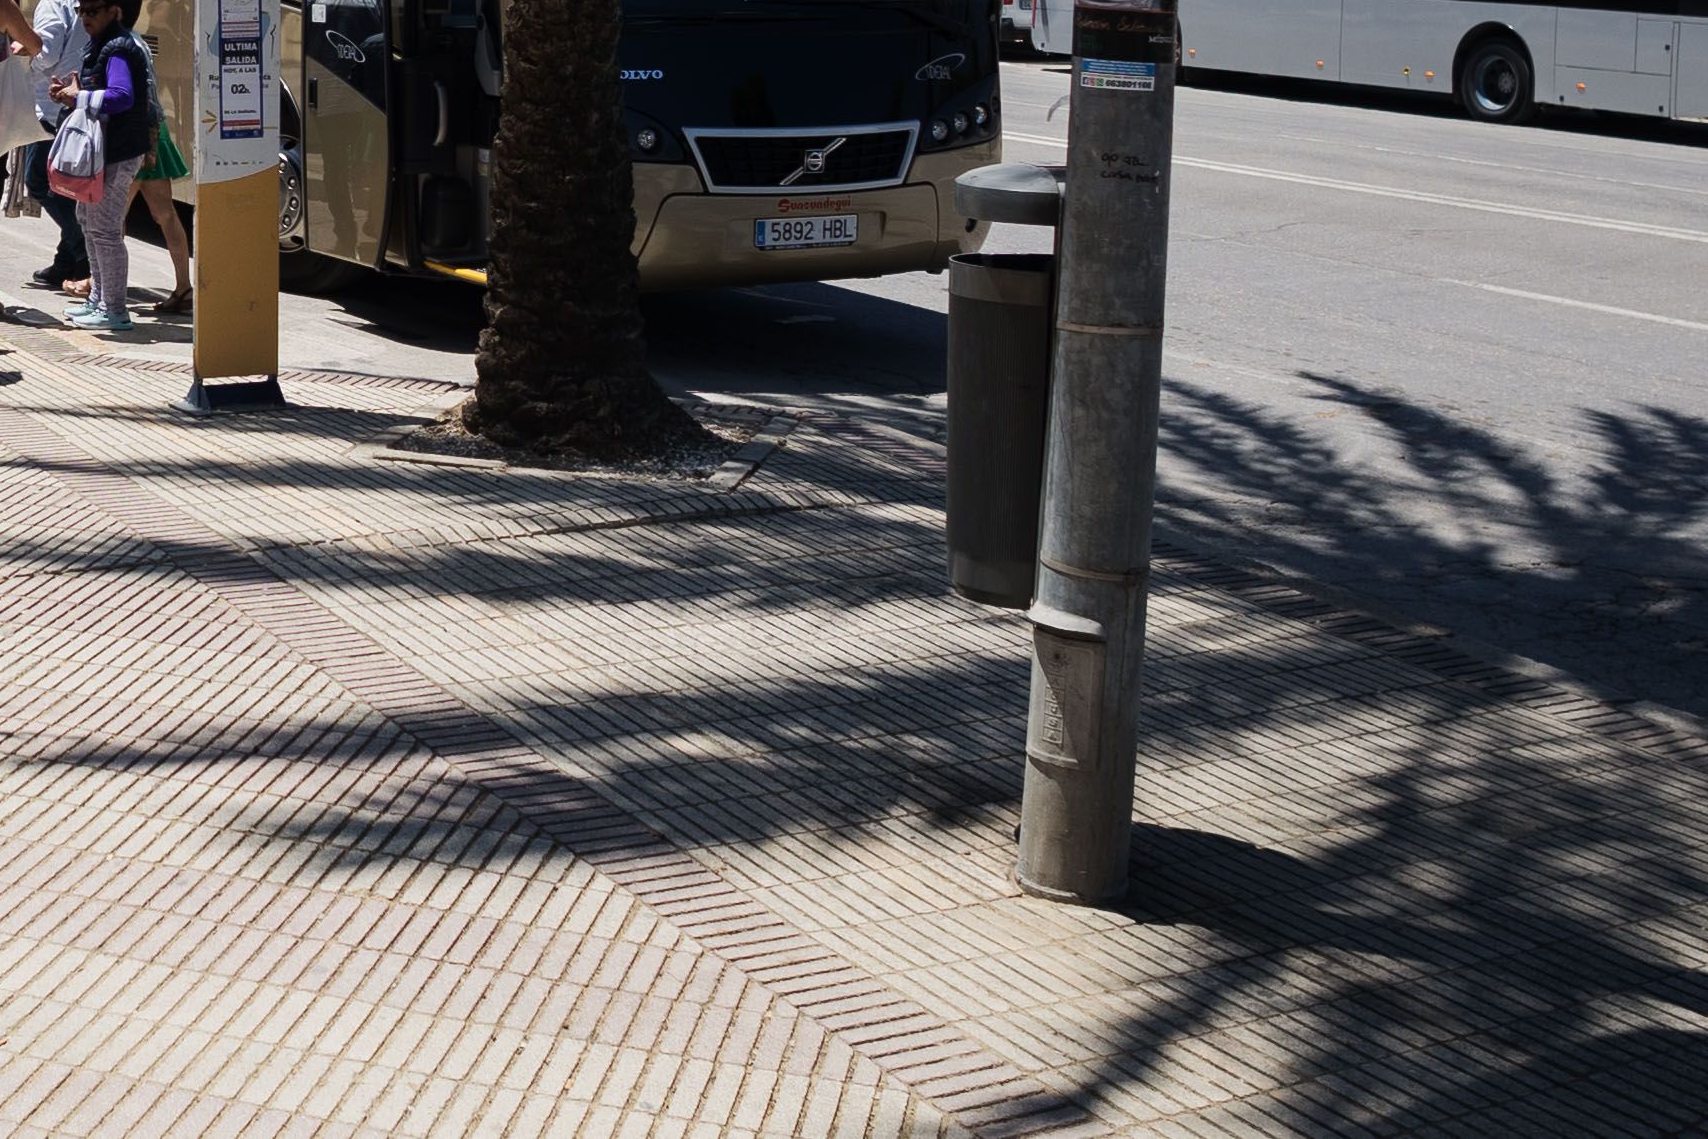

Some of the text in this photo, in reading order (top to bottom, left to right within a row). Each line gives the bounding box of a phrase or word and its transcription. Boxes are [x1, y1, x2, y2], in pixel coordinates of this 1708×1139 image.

[224, 42, 257, 51] ULTIMA
[225, 56, 257, 64] SALIDA
[620, 69, 663, 80] OLVO
[771, 218, 853, 242] 5892 HBL
